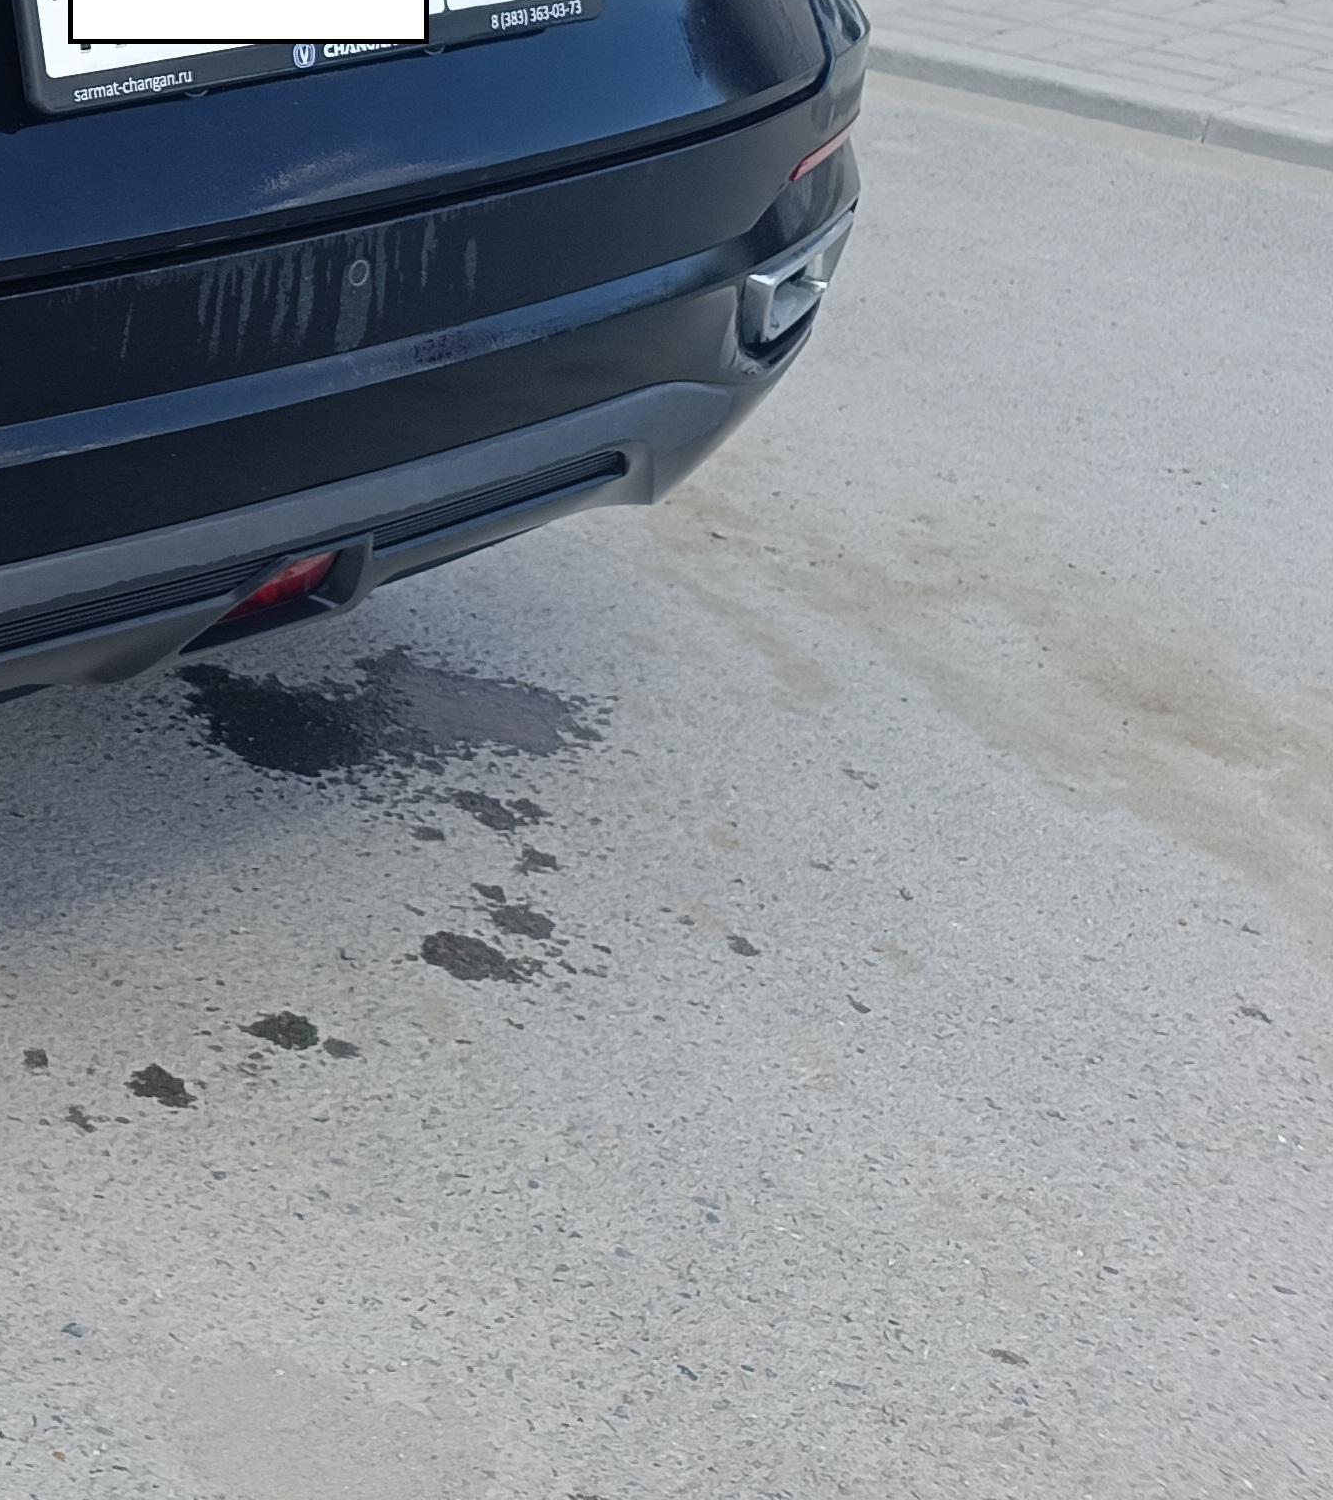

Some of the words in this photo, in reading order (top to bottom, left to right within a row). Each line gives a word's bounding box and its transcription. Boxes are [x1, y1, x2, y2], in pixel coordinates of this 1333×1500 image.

[491, 14, 499, 30] 8
[500, 8, 528, 31] (383)
[529, 0, 582, 23] 363-03-73
[73, 70, 194, 102] sarmat-changan.ru
